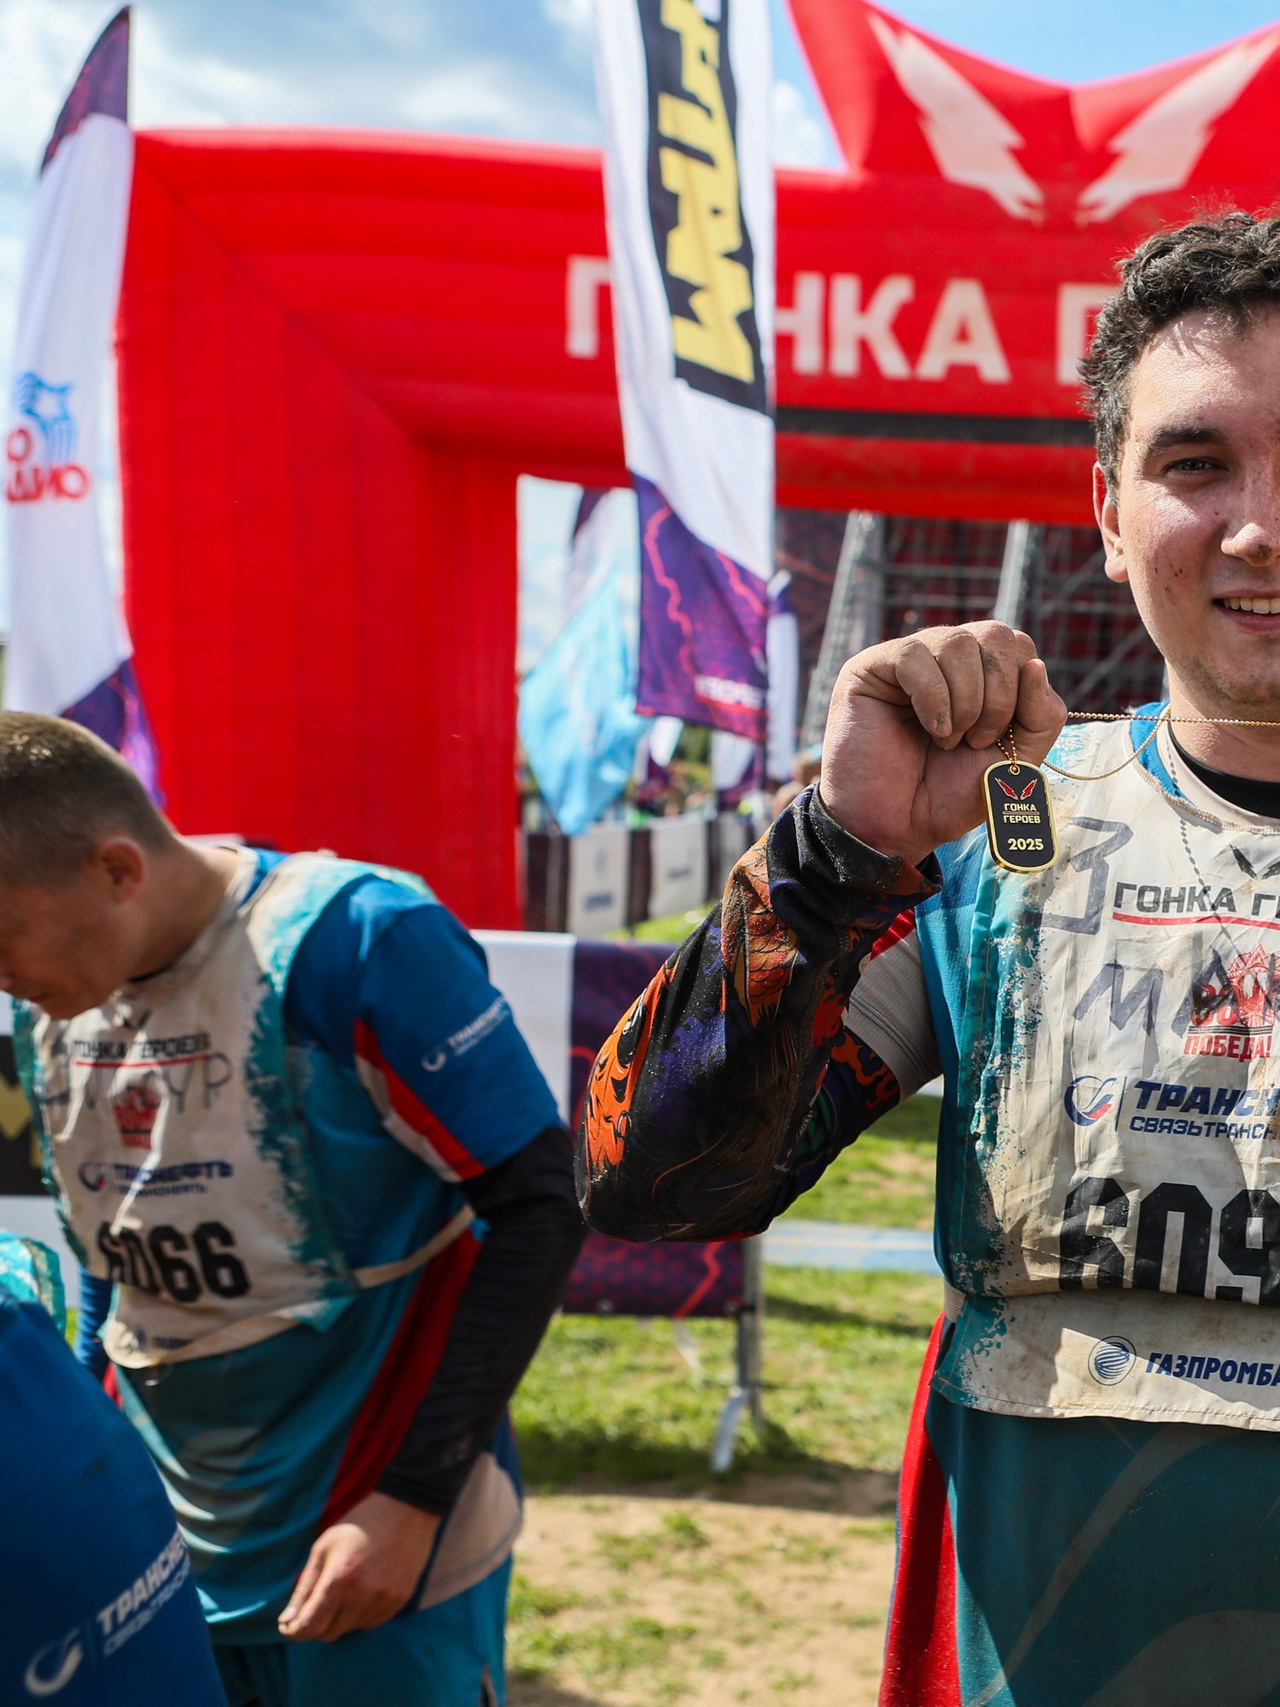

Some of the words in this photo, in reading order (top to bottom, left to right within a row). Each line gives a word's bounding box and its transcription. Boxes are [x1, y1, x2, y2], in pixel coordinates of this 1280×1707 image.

[1003, 803, 1037, 811] ГОНКА
[1003, 815, 1041, 824] ГЕРОЕВ
[1008, 838, 1044, 850] 2025
[1115, 881, 1236, 914] ГОНКА
[1184, 1034, 1273, 1063] ПОБЕДА!
[98, 1220, 250, 1303] 6066
